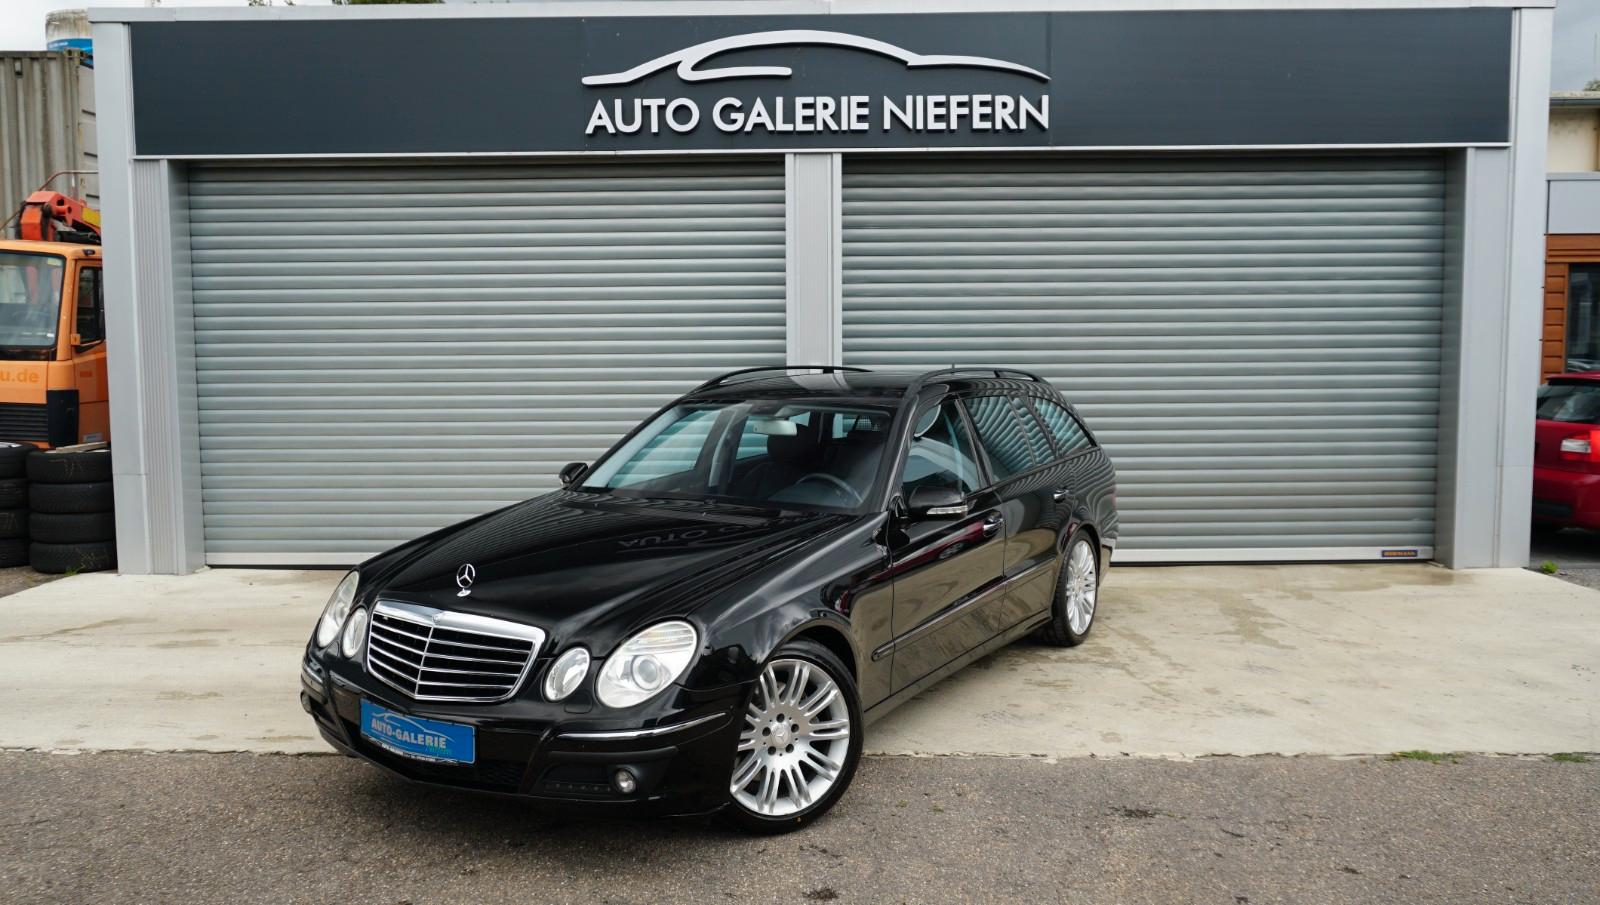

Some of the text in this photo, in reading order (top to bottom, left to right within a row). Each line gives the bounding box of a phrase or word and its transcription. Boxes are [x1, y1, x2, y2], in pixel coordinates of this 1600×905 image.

[585, 93, 1050, 134] AUTO GALERIE NIEFERN
[371, 718, 447, 748] AUTO-GALERIE
